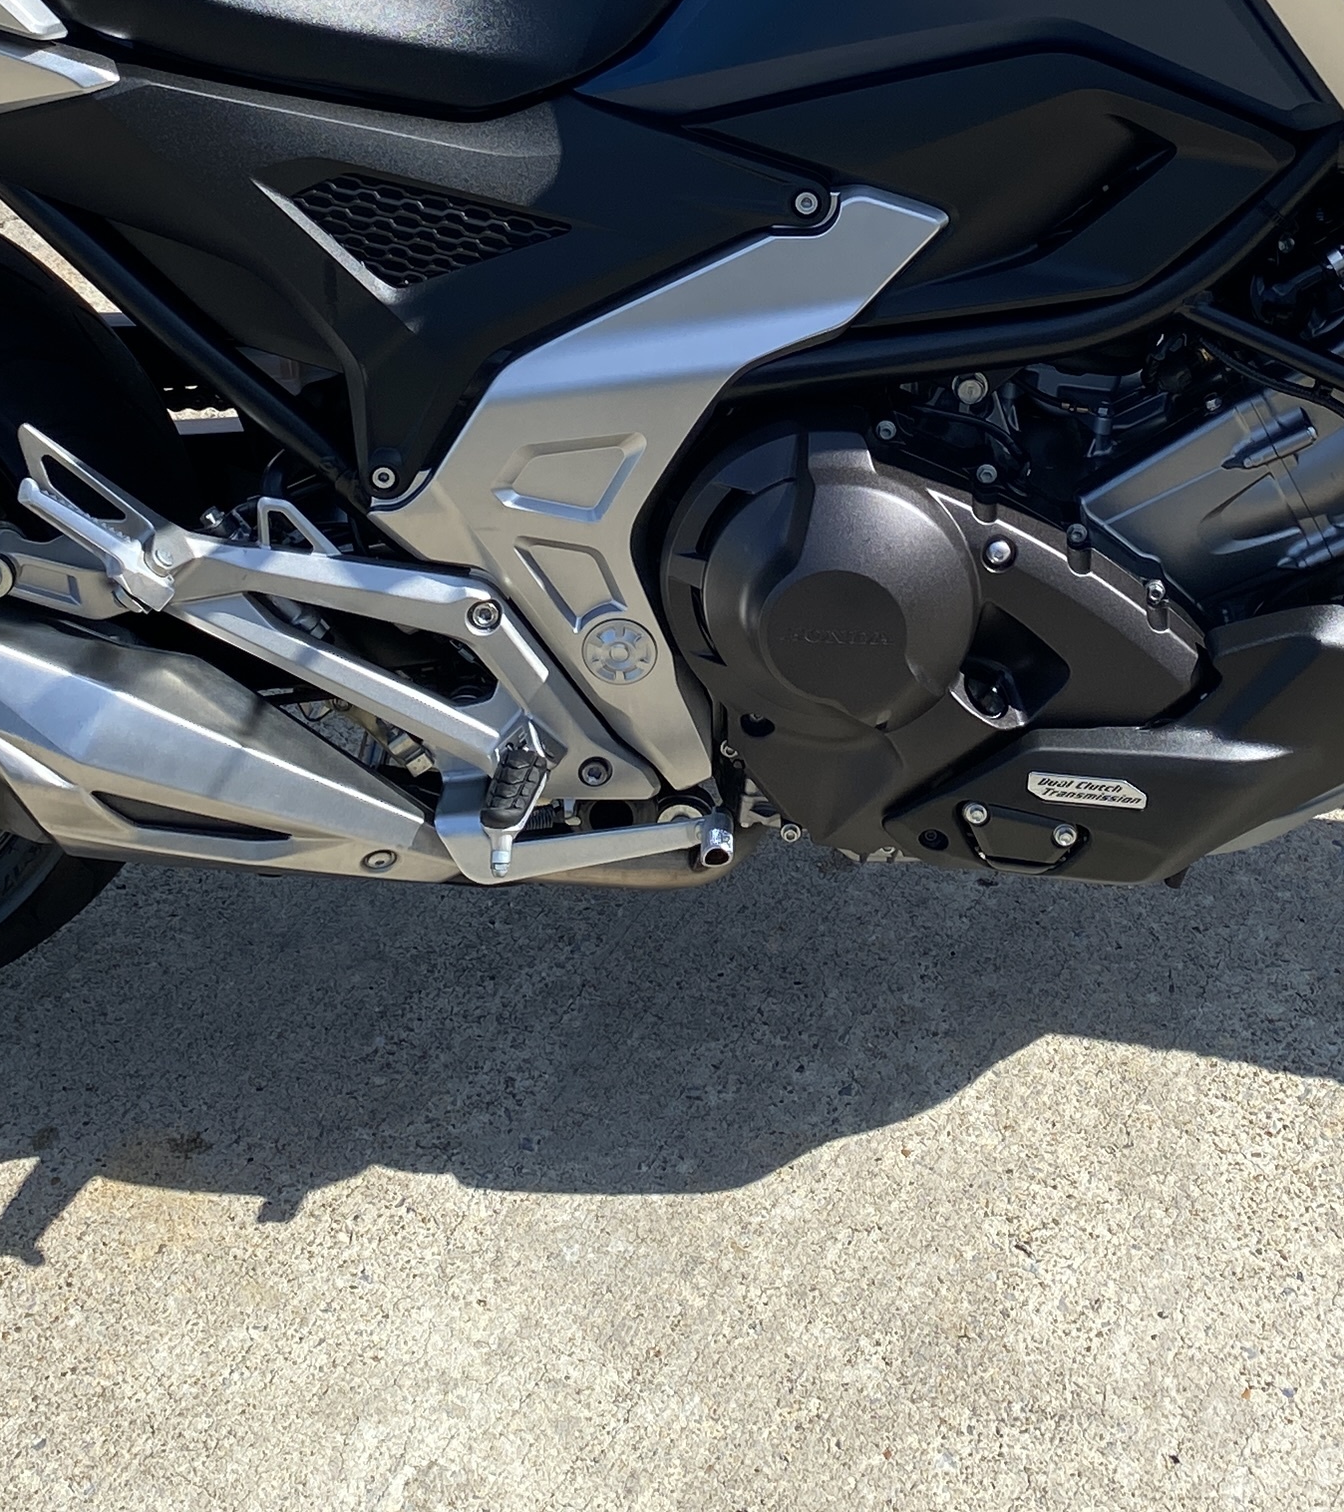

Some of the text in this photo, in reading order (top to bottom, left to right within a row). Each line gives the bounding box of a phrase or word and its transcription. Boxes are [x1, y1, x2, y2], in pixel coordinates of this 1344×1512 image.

[1037, 777, 1123, 793] Dual Clutch
[1042, 787, 1143, 804] Transmission
